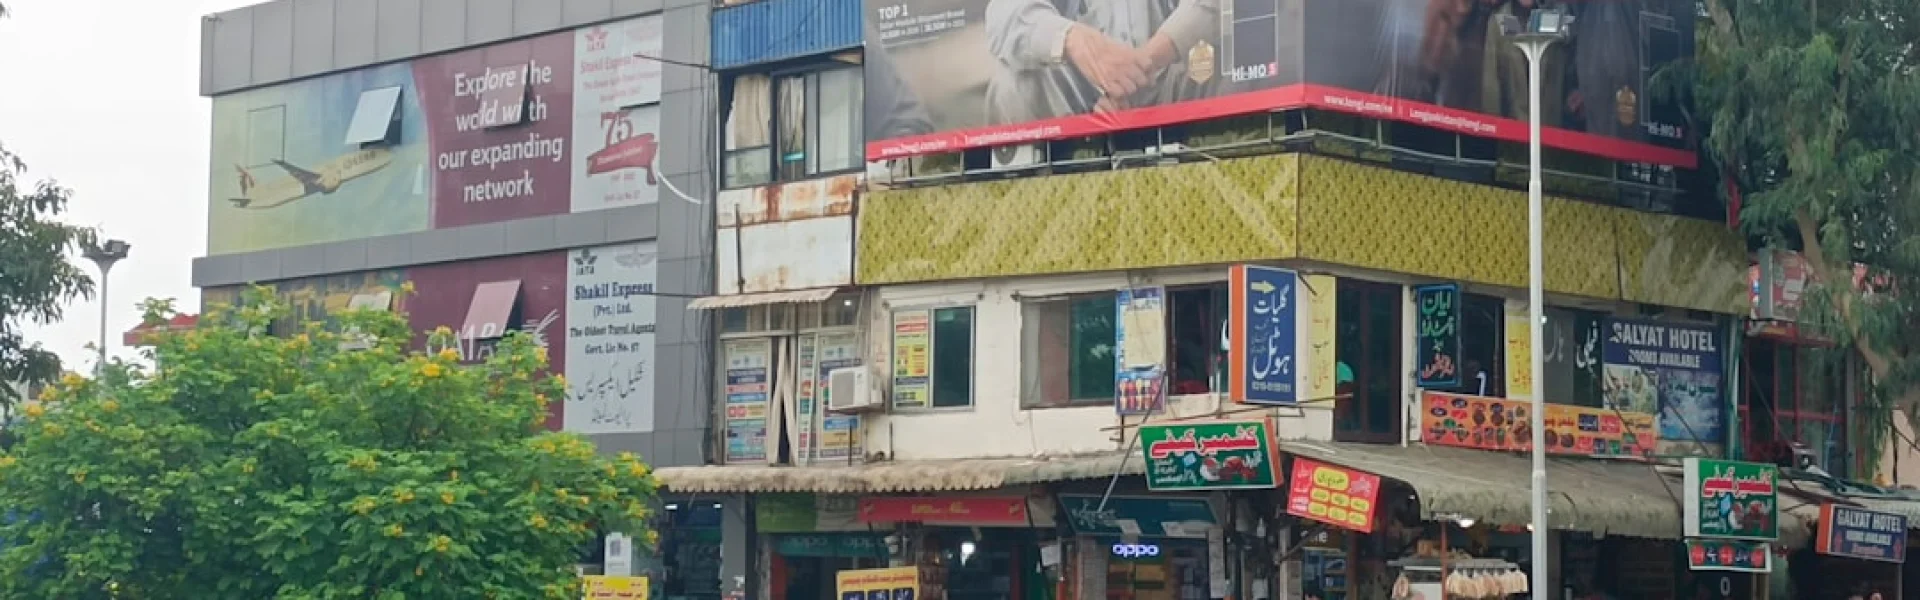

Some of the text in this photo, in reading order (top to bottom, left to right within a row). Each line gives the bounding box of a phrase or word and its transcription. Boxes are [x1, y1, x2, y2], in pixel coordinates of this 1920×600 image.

[878, 4, 908, 20] TOP 1
[454, 67, 517, 100] Explore
[439, 132, 563, 170] our expanding
[463, 169, 534, 203] network
[574, 282, 653, 300] Shakil Express
[570, 327, 582, 338] The
[608, 323, 629, 335] Travel
[1668, 328, 1716, 353] HOTEL
[1872, 513, 1902, 534] HOTEL
[1112, 543, 1160, 558] oppo
